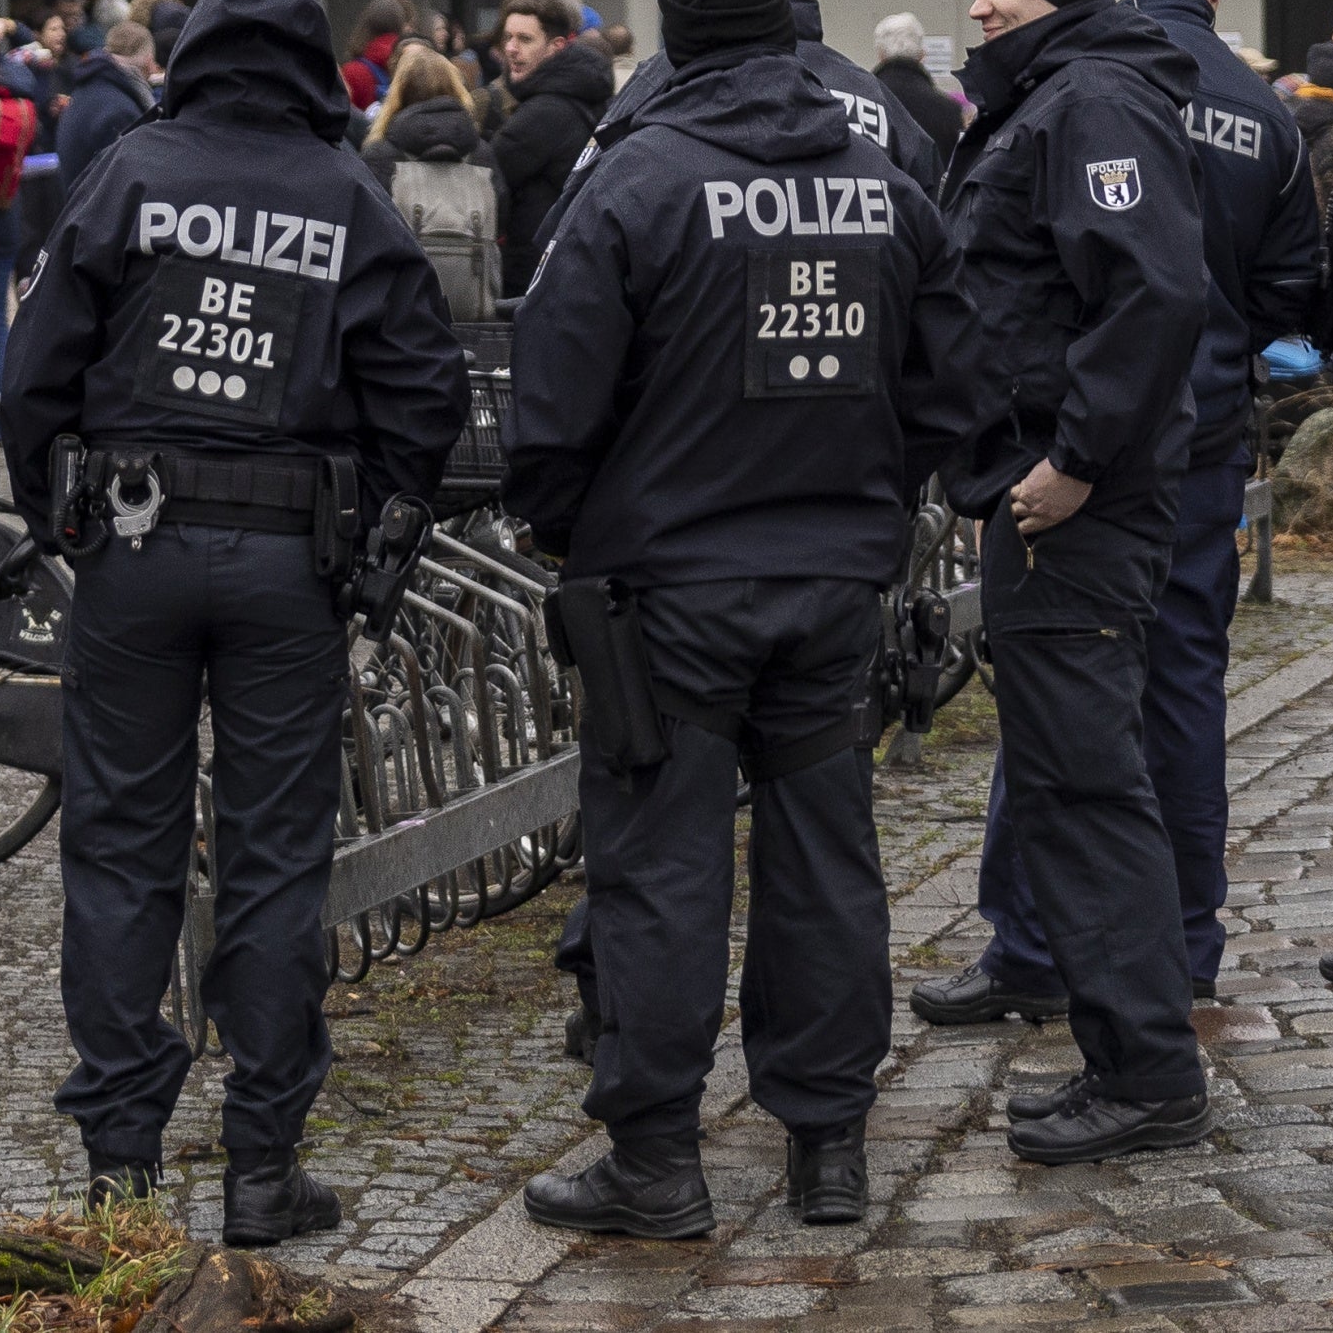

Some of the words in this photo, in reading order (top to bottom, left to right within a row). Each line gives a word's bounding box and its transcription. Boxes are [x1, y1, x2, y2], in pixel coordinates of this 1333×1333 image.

[1179, 101, 1262, 159] LIZEI
[1090, 160, 1135, 175] POLIZEI
[704, 177, 894, 239] POLIZEI
[139, 202, 347, 282] POLIZEI
[199, 276, 256, 321] BE
[790, 260, 837, 296] BE
[157, 313, 275, 368] 22301
[757, 302, 865, 338] 22310
